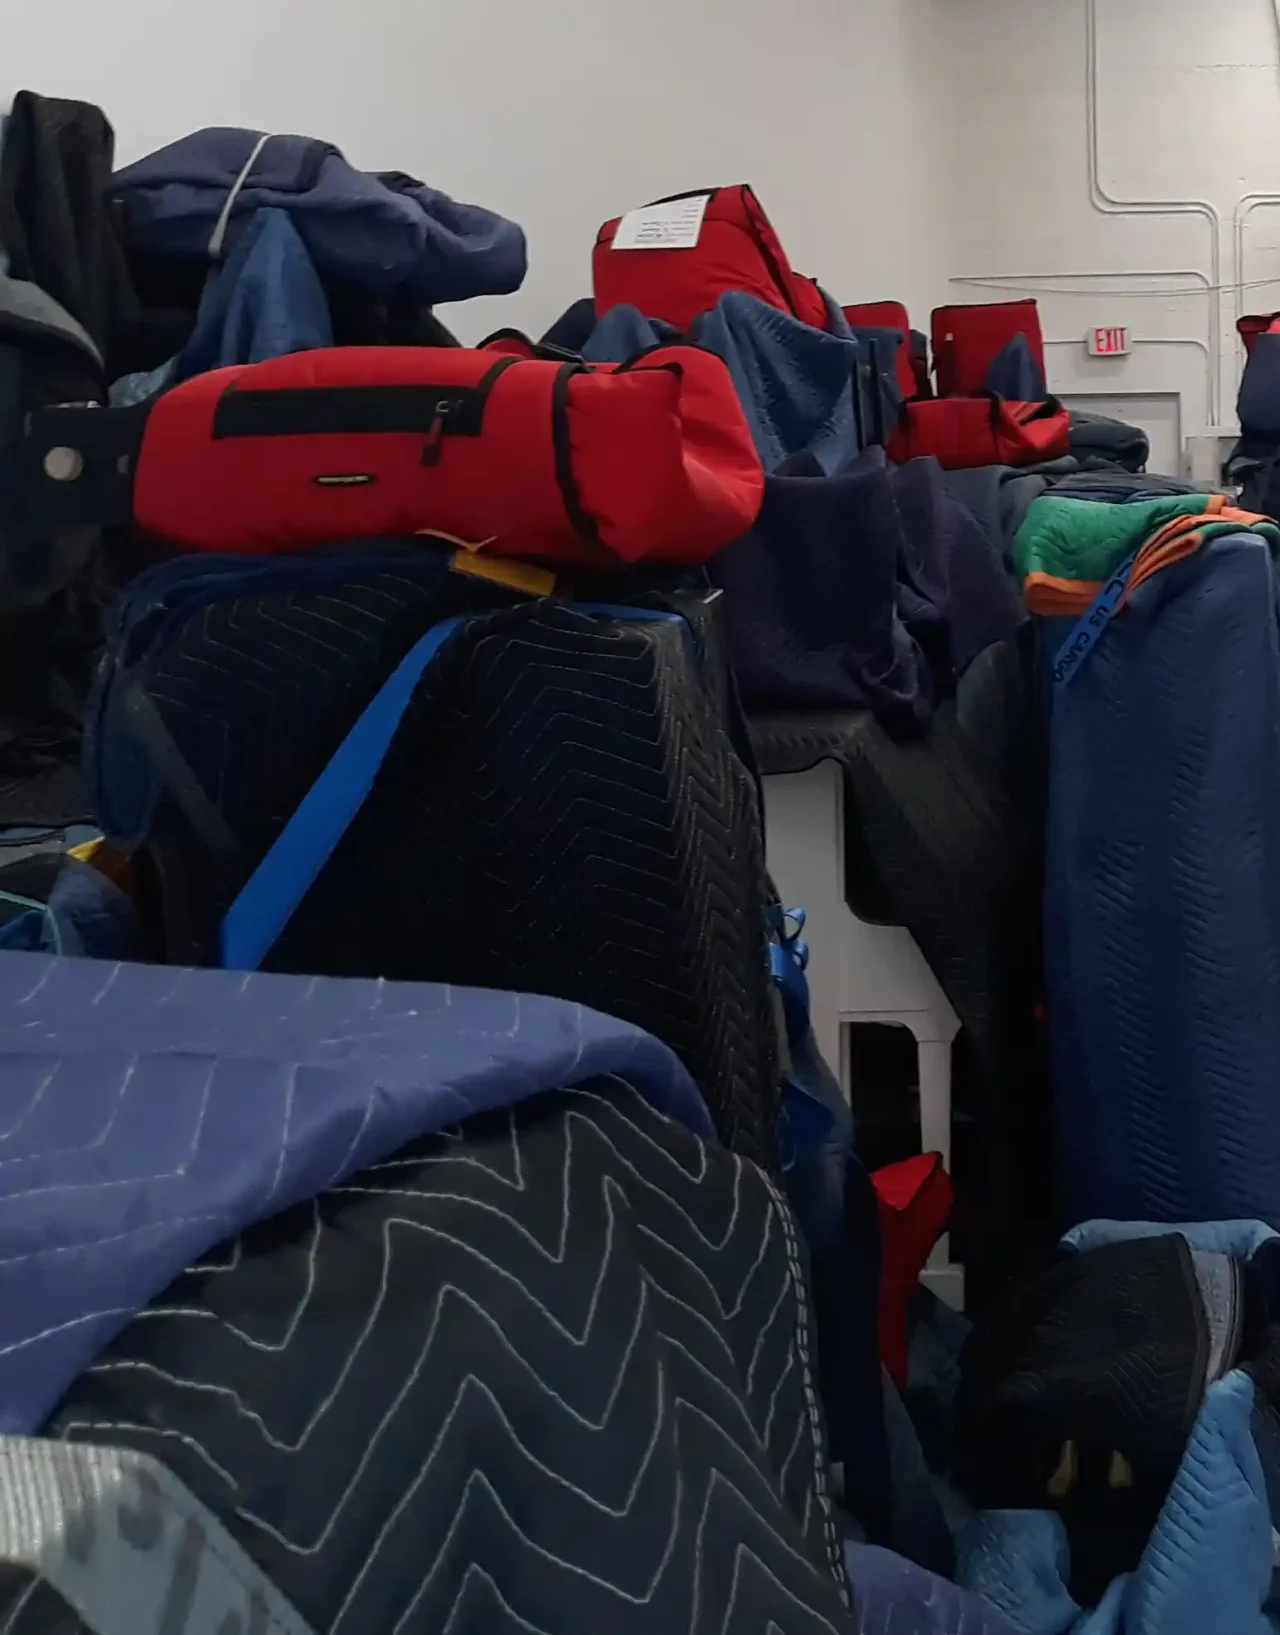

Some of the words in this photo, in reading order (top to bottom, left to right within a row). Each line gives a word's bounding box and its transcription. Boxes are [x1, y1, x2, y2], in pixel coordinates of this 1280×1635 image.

[1095, 328, 1125, 352] EXIT
[1088, 605, 1110, 628] US
[1053, 631, 1091, 683] CARGO
